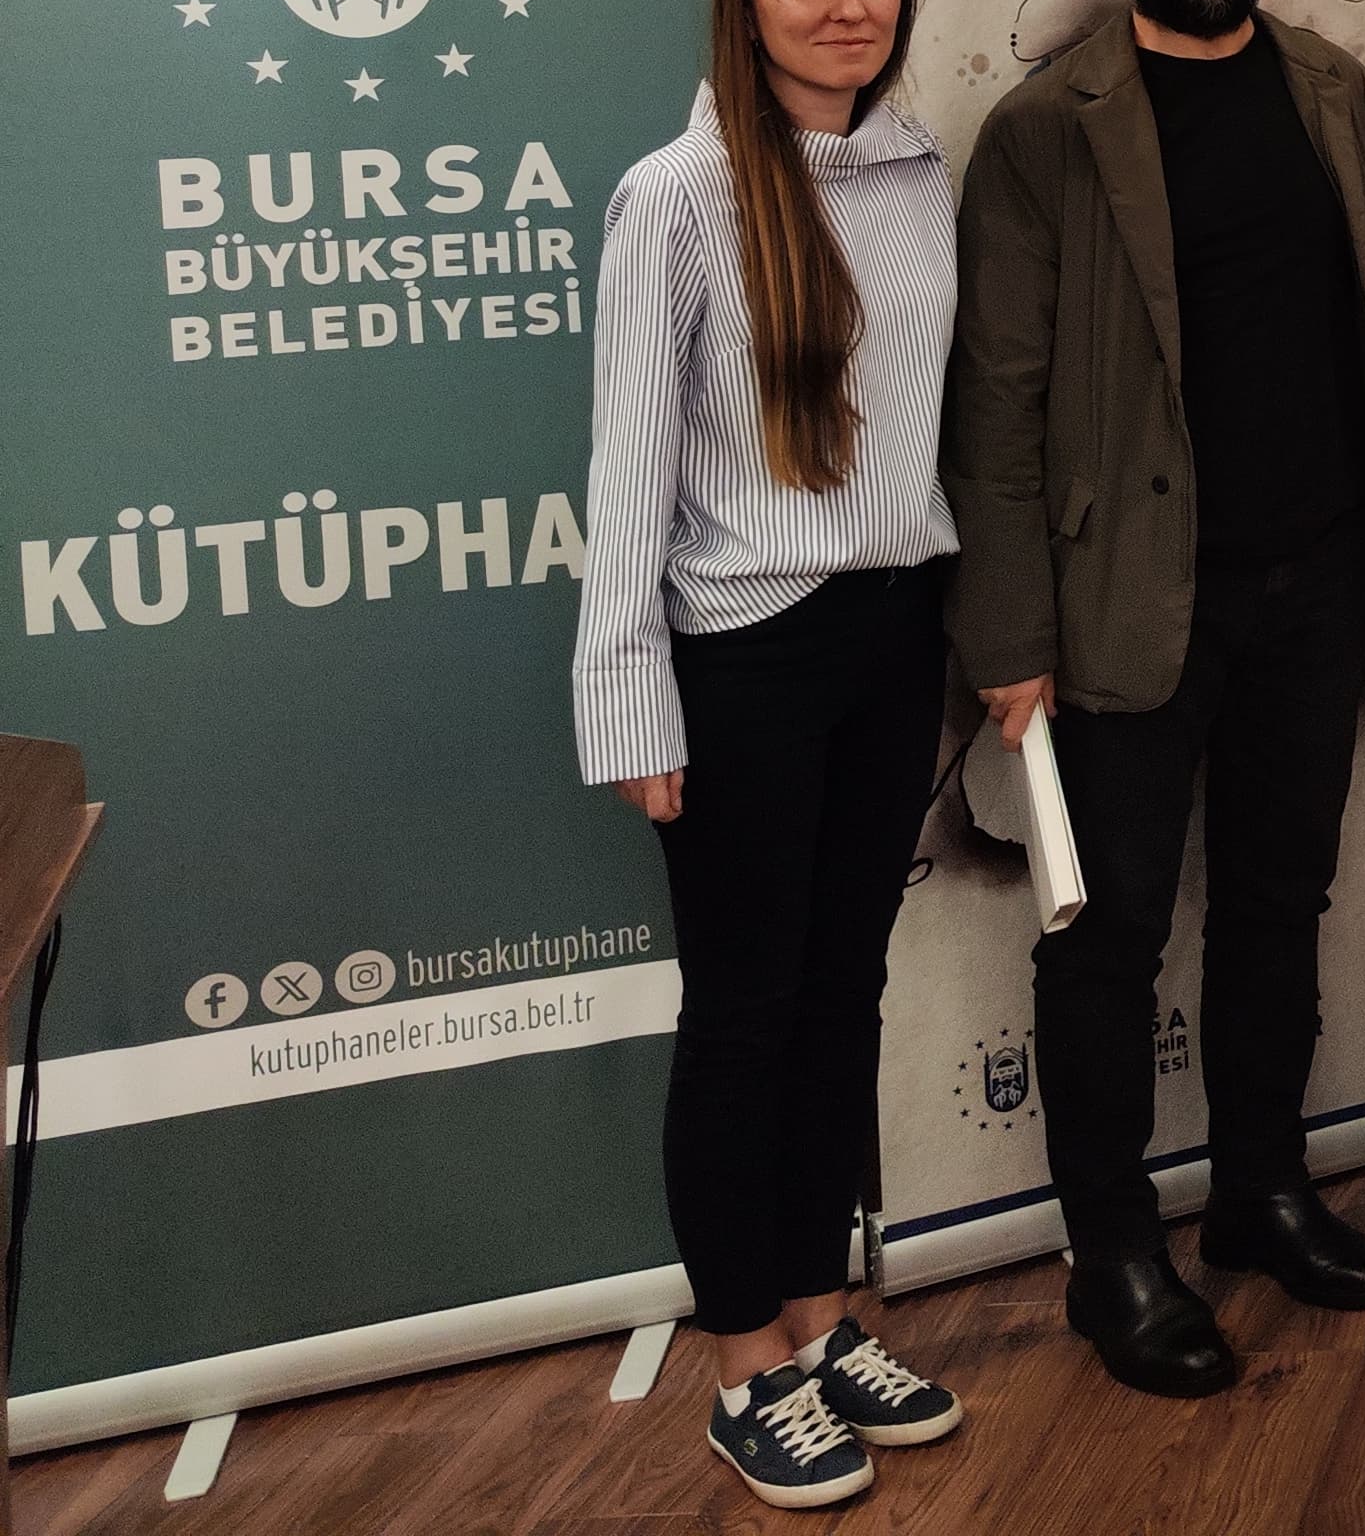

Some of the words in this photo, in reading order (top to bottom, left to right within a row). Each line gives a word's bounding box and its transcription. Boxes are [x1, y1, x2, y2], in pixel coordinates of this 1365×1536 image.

[158, 142, 574, 230] BURSA
[165, 216, 577, 296] BÜYÜKŞEHİR
[170, 276, 583, 362] BELEDİYESİ
[406, 921, 652, 988] bursakutuphane
[250, 992, 597, 1078] kutuphaneler.bursa.bel.tr
